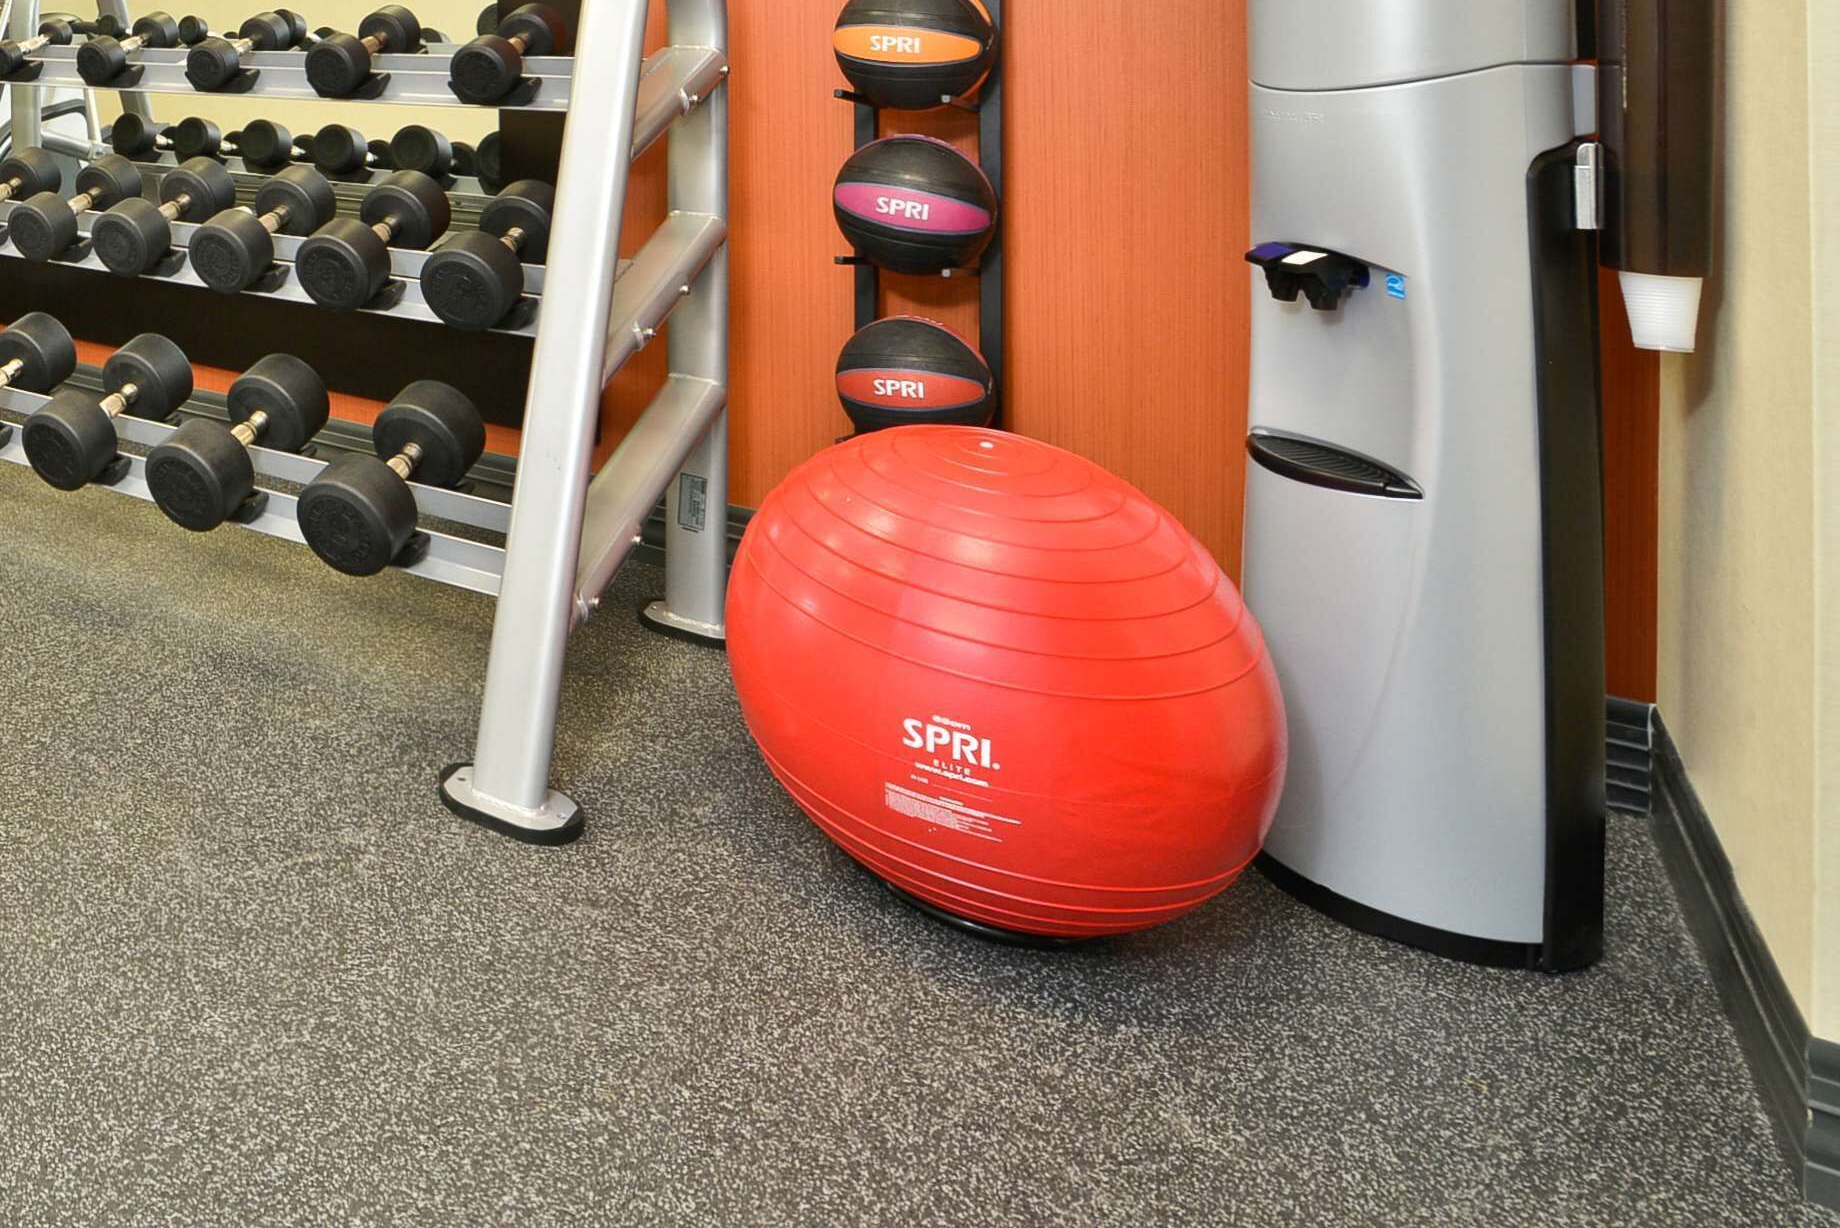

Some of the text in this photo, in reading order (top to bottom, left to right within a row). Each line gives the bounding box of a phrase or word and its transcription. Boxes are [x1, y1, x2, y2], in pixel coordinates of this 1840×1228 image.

[870, 35, 921, 53] SPRI
[875, 196, 929, 221] SPRI
[873, 379, 924, 398] SPRI
[933, 758, 971, 775] ELITE
